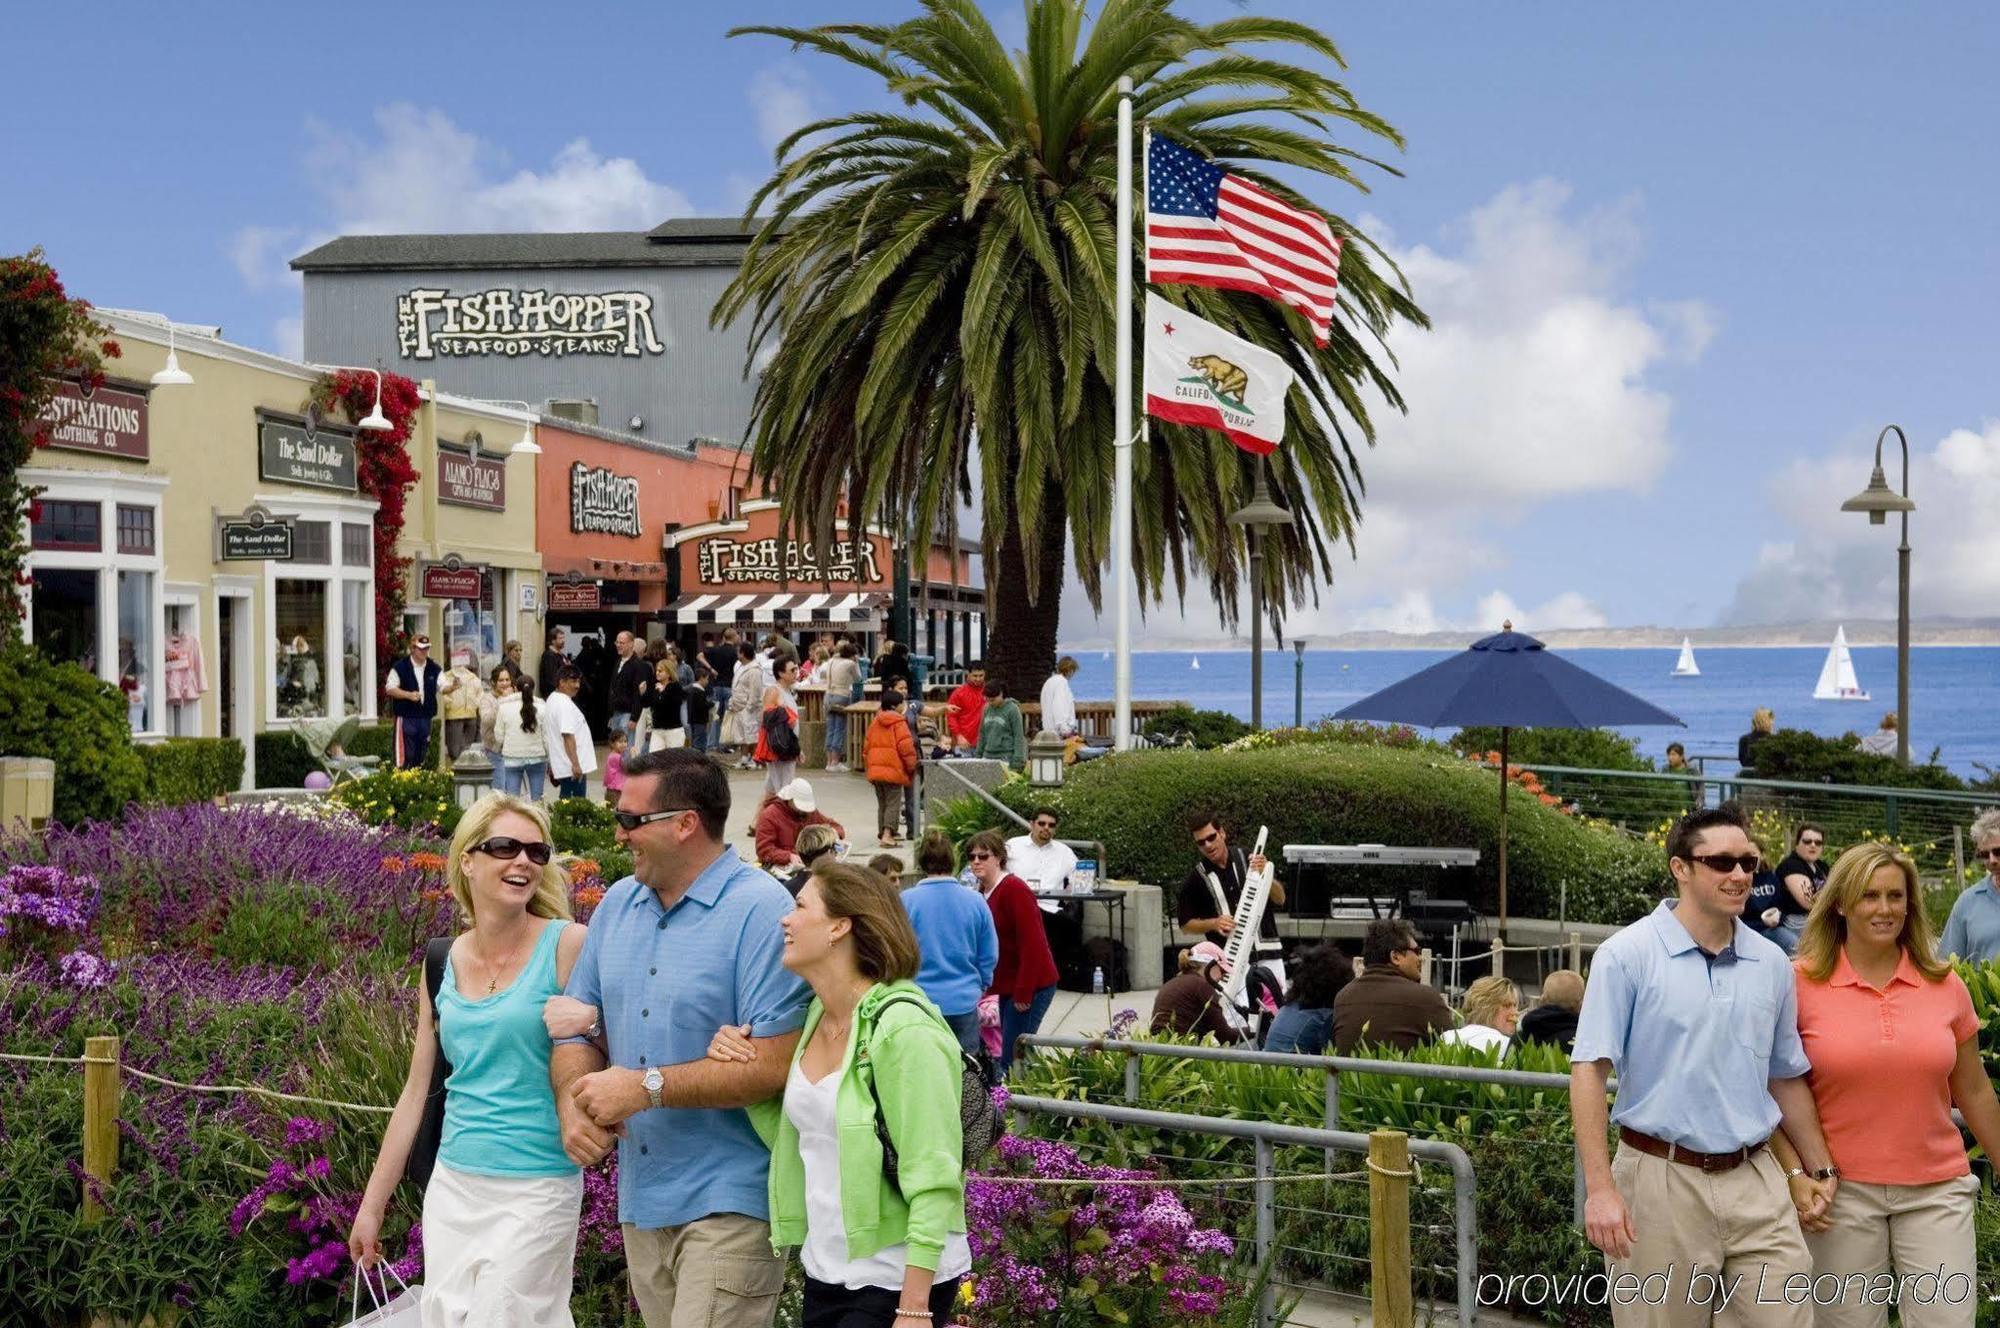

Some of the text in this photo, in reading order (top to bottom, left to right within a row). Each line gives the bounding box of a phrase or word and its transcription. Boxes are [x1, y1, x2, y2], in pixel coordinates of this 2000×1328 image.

[399, 288, 666, 358] THE FISH HOPPER
[1175, 385, 1214, 401] CALIFO
[53, 425, 118, 447] CLOTHING CO.
[279, 436, 343, 467] The Sand Dollar
[445, 461, 500, 491] ALAMO FLAGS
[229, 535, 286, 544] The Sand Dollar
[708, 539, 778, 583] FISH
[727, 569, 791, 582] SEAFOO
[1750, 884, 1776, 897] etto
